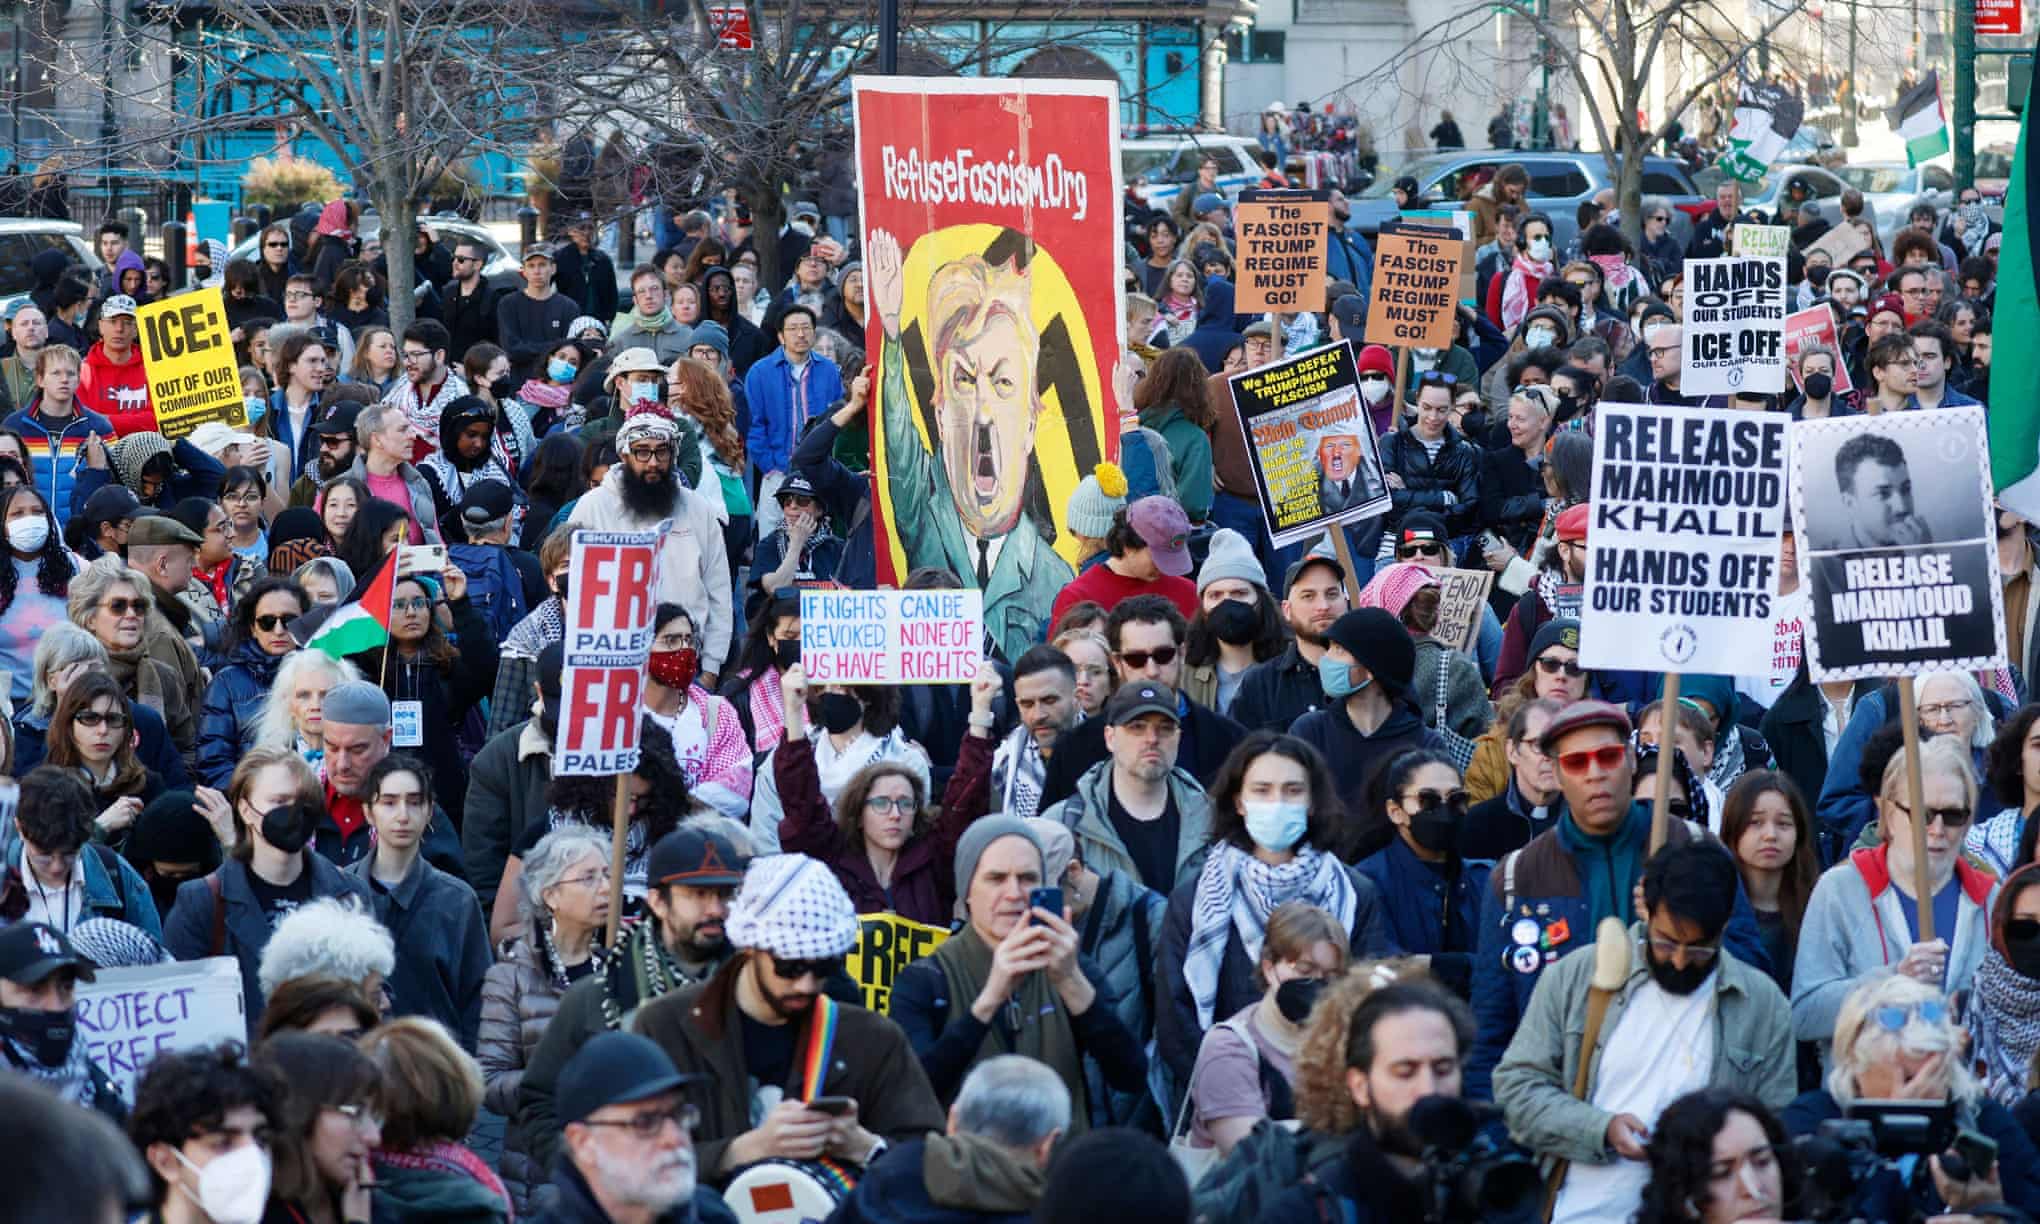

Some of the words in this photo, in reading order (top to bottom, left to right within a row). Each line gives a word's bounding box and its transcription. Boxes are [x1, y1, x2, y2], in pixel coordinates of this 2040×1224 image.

[882, 145, 1087, 220] RefuseFascism.Org
[1267, 206, 1301, 219] The
[1243, 222, 1323, 236] FASCIST
[1249, 240, 1316, 254] TRUMP
[1406, 240, 1439, 255] The
[1246, 256, 1319, 271] REGIME
[1380, 253, 1458, 273] FASCIST
[1693, 260, 1781, 292] HANDS
[1255, 274, 1308, 288] MUST
[1385, 271, 1449, 289] TRUMP
[1265, 291, 1297, 305] GO!
[1379, 288, 1450, 307] REGIME
[1695, 289, 1780, 308] OFF
[1386, 307, 1439, 323] MUST
[1693, 308, 1719, 323] OUR
[1722, 305, 1782, 322] STUDENTS
[144, 303, 222, 362] ICE:
[1394, 324, 1427, 339] GO!
[1692, 332, 1732, 361] ICE
[1738, 329, 1781, 358] OFF
[1242, 377, 1263, 391] We
[1264, 367, 1295, 383] Must
[1297, 349, 1342, 375] DEFEAT
[1692, 359, 1718, 369] OUR
[155, 379, 182, 398] OUT
[184, 374, 200, 392] OF
[203, 366, 234, 387] OUR
[1254, 365, 1338, 399] TRUMP/MAGA
[1272, 381, 1328, 407] FASCISM
[159, 384, 236, 414] COMMUNITIES!
[1605, 414, 1784, 468] RELEASE
[1599, 464, 1780, 508] MAHMOUD
[1597, 504, 1777, 538] KHALIL
[1595, 547, 1710, 587] HANDS
[1719, 553, 1775, 590] OFF
[1845, 554, 1954, 590] RELEASE
[802, 595, 818, 619] IF
[823, 595, 886, 620] RIGHTS
[900, 594, 939, 618] CAN
[942, 595, 963, 618] BE
[1592, 586, 1641, 613] OUR
[1649, 588, 1770, 619] STUDENTS
[1831, 584, 1972, 624] MAHMOUD
[900, 621, 948, 647] NONE
[951, 620, 975, 647] OF
[1861, 617, 1950, 652] KHALIL
[803, 652, 831, 680] US
[836, 651, 888, 680] HAVE
[900, 651, 977, 680] RIGHTS
[75, 987, 195, 1033] ROTECT
